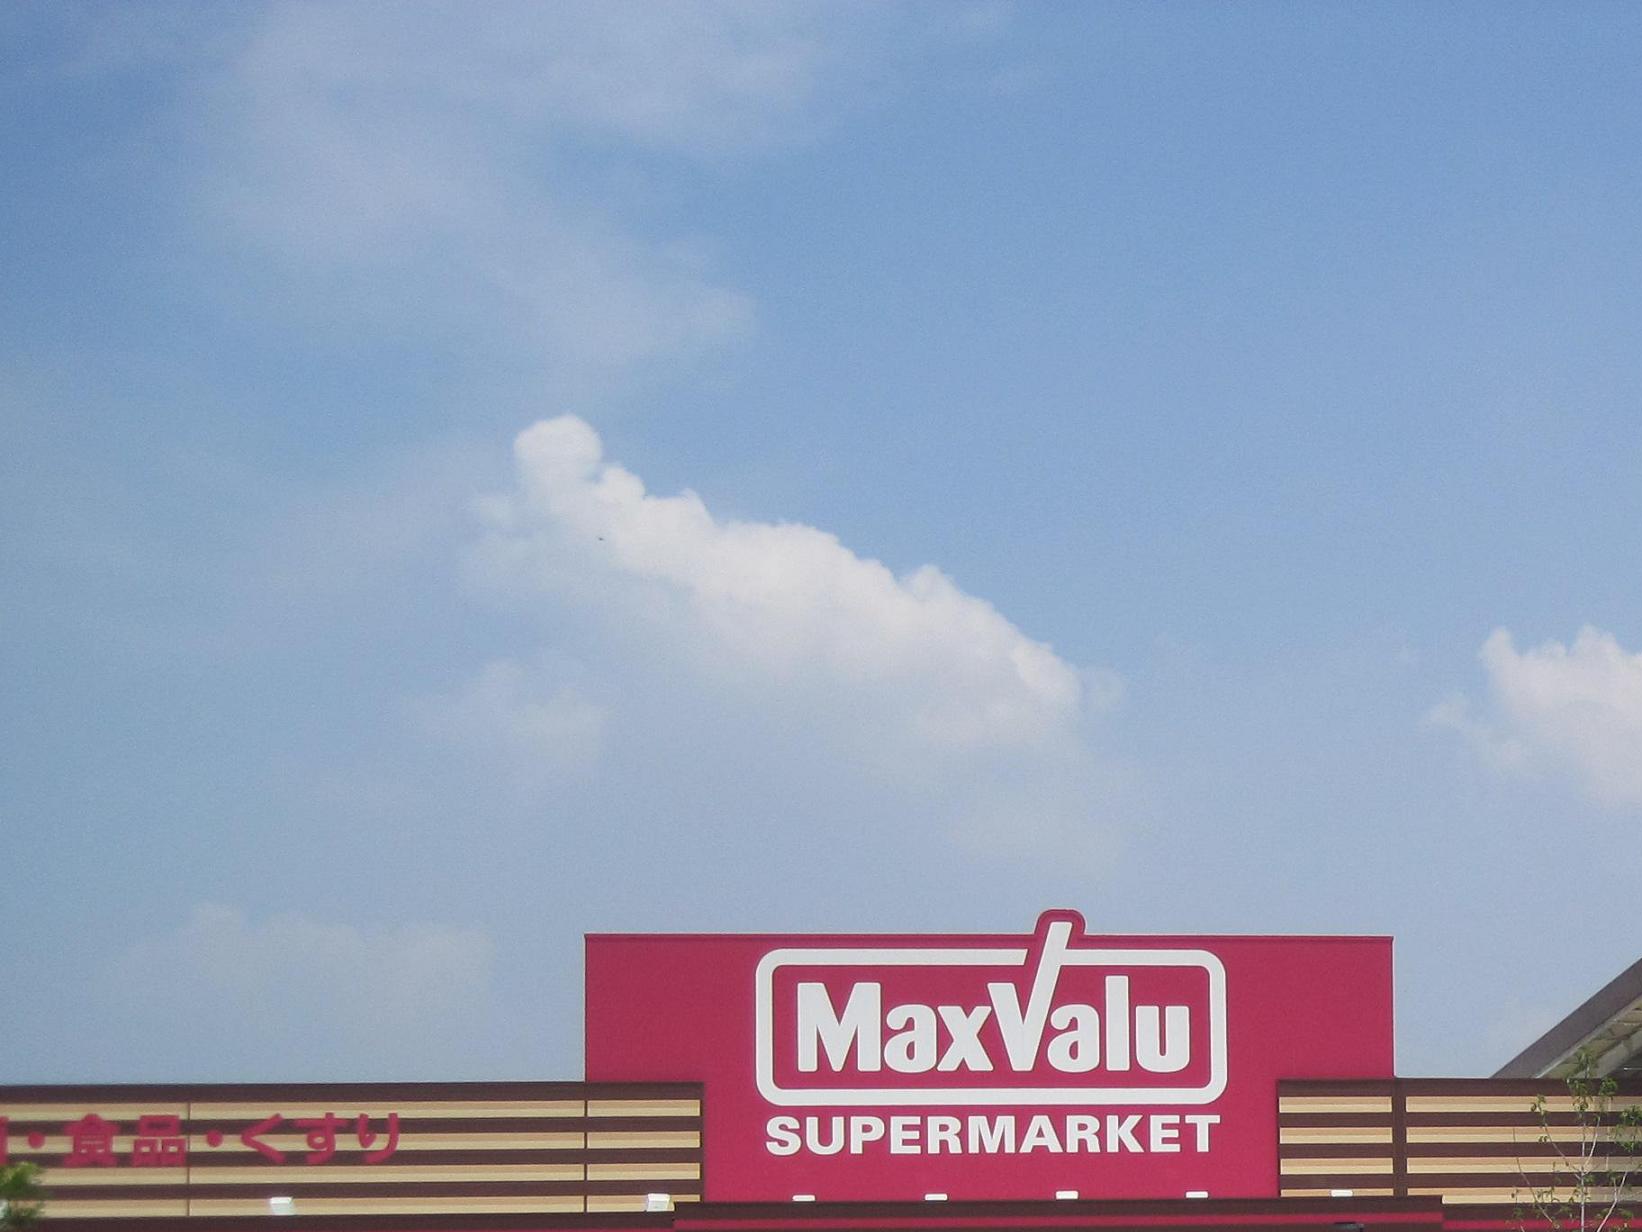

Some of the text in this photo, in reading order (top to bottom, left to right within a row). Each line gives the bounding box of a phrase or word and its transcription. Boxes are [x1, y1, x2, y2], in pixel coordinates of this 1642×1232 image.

[797, 921, 1191, 1074] MaxValu
[0, 1113, 400, 1168] ・食品・くすり
[765, 1115, 1221, 1156] SUPERMARKET
